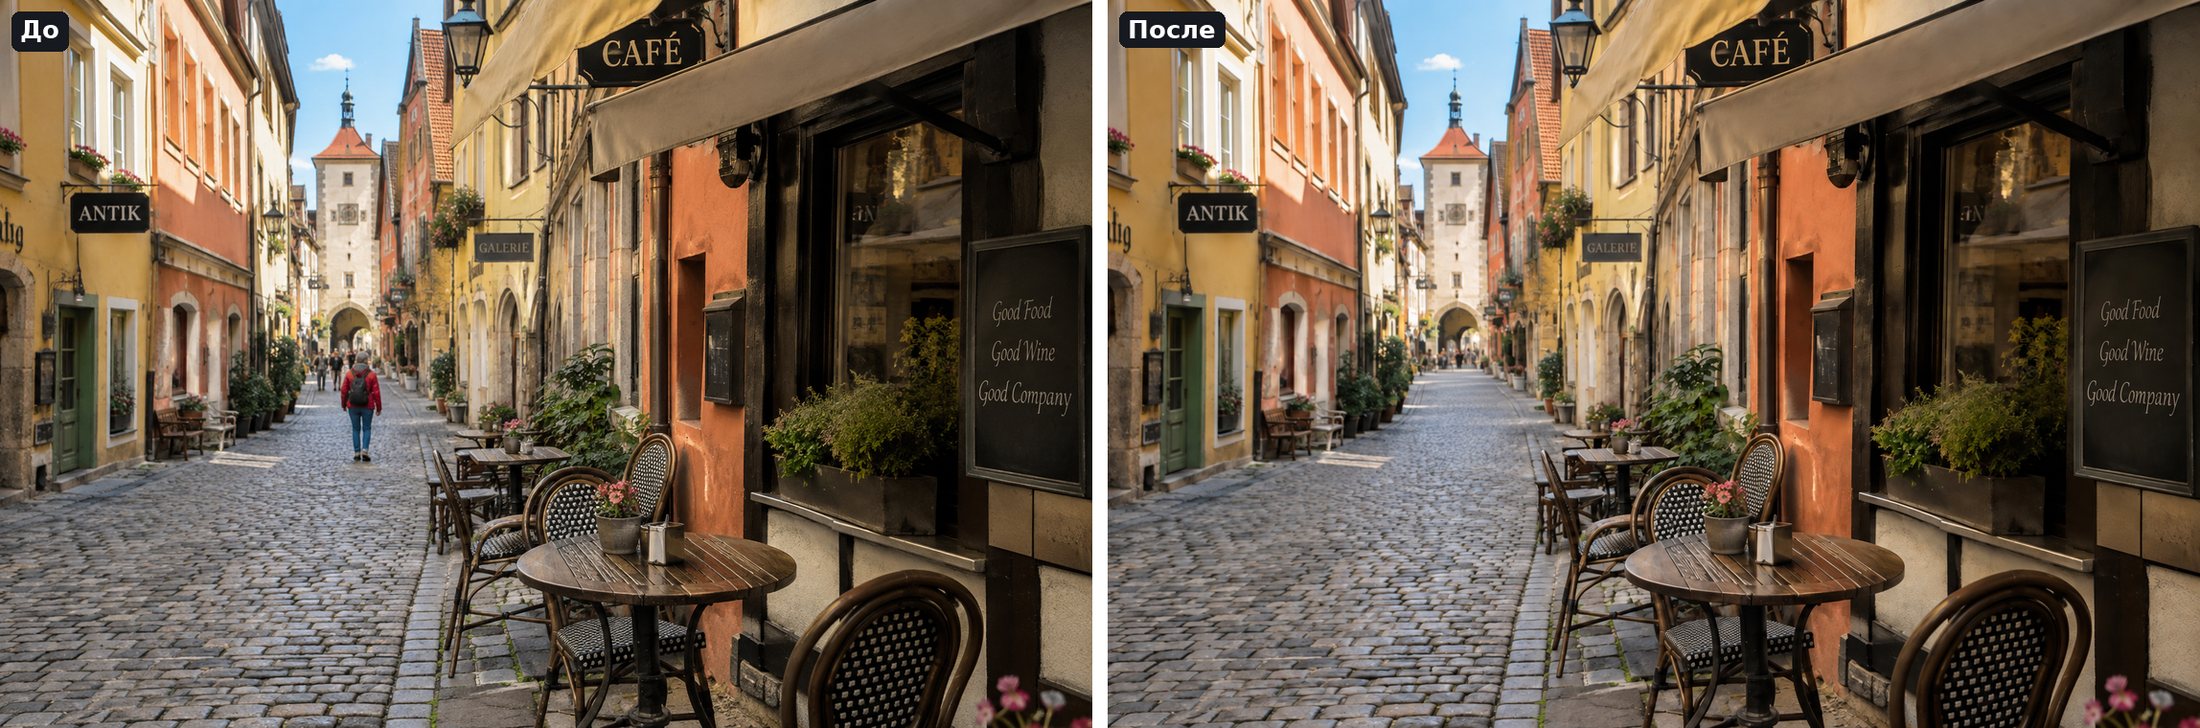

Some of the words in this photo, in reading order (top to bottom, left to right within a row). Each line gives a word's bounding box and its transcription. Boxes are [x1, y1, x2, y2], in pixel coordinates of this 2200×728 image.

[602, 31, 682, 68] CAFÉ
[1710, 31, 1791, 68] CAFÉ
[79, 205, 141, 221] ANTIK
[1186, 205, 1249, 221] ANTIK
[479, 242, 529, 253] GALERIE
[1586, 242, 1637, 253] GALERIE
[993, 299, 1022, 327] Good
[1024, 296, 1053, 320] Food
[2101, 299, 2130, 327] Good
[2132, 296, 2161, 320] Food
[992, 339, 1022, 367] Good
[1023, 340, 1056, 362] Wine
[2100, 339, 2130, 367] Good
[2131, 340, 2164, 362] Wine
[979, 380, 1010, 407] Good
[1012, 381, 1072, 416] Company
[2087, 380, 2118, 407] Good
[2120, 381, 2180, 416] Company
